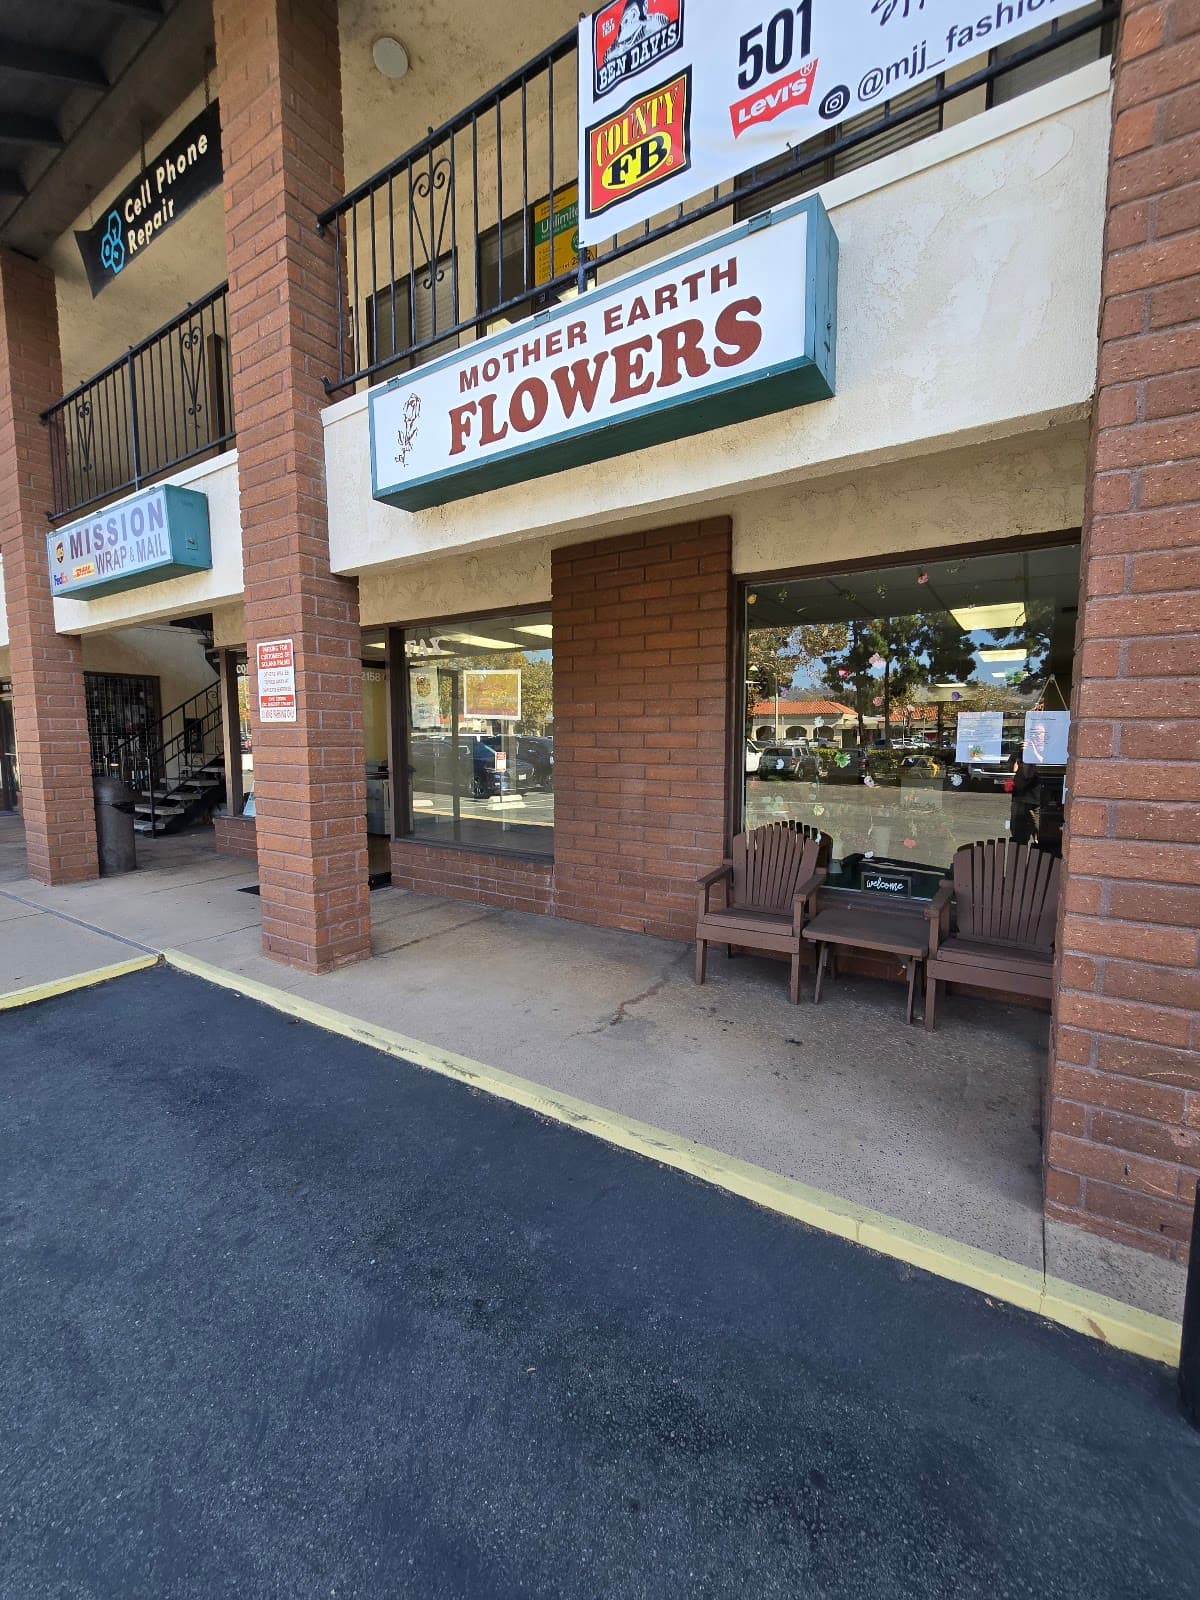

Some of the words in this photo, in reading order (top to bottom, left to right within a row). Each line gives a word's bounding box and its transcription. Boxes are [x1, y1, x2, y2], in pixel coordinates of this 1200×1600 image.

[599, 54, 627, 91] BEN
[630, 22, 678, 71] DAVIS
[737, 0, 812, 90] 501
[857, 0, 1053, 101] @mjj_fashio
[596, 87, 679, 167] COUNTY
[124, 178, 152, 224] Cell
[156, 134, 208, 194] Phone
[607, 134, 668, 187] FB
[127, 198, 174, 255] Repair
[459, 320, 587, 393] MOTHER
[603, 256, 738, 335] EARTH
[448, 295, 763, 456] FLOWERS
[69, 498, 164, 560] MISSION
[94, 545, 127, 576] WRAP
[129, 546, 135, 562] &
[136, 533, 167, 563] MAIL
[236, 663, 249, 674] CO
[404, 638, 441, 658] FAX
[866, 876, 905, 892] welcome
